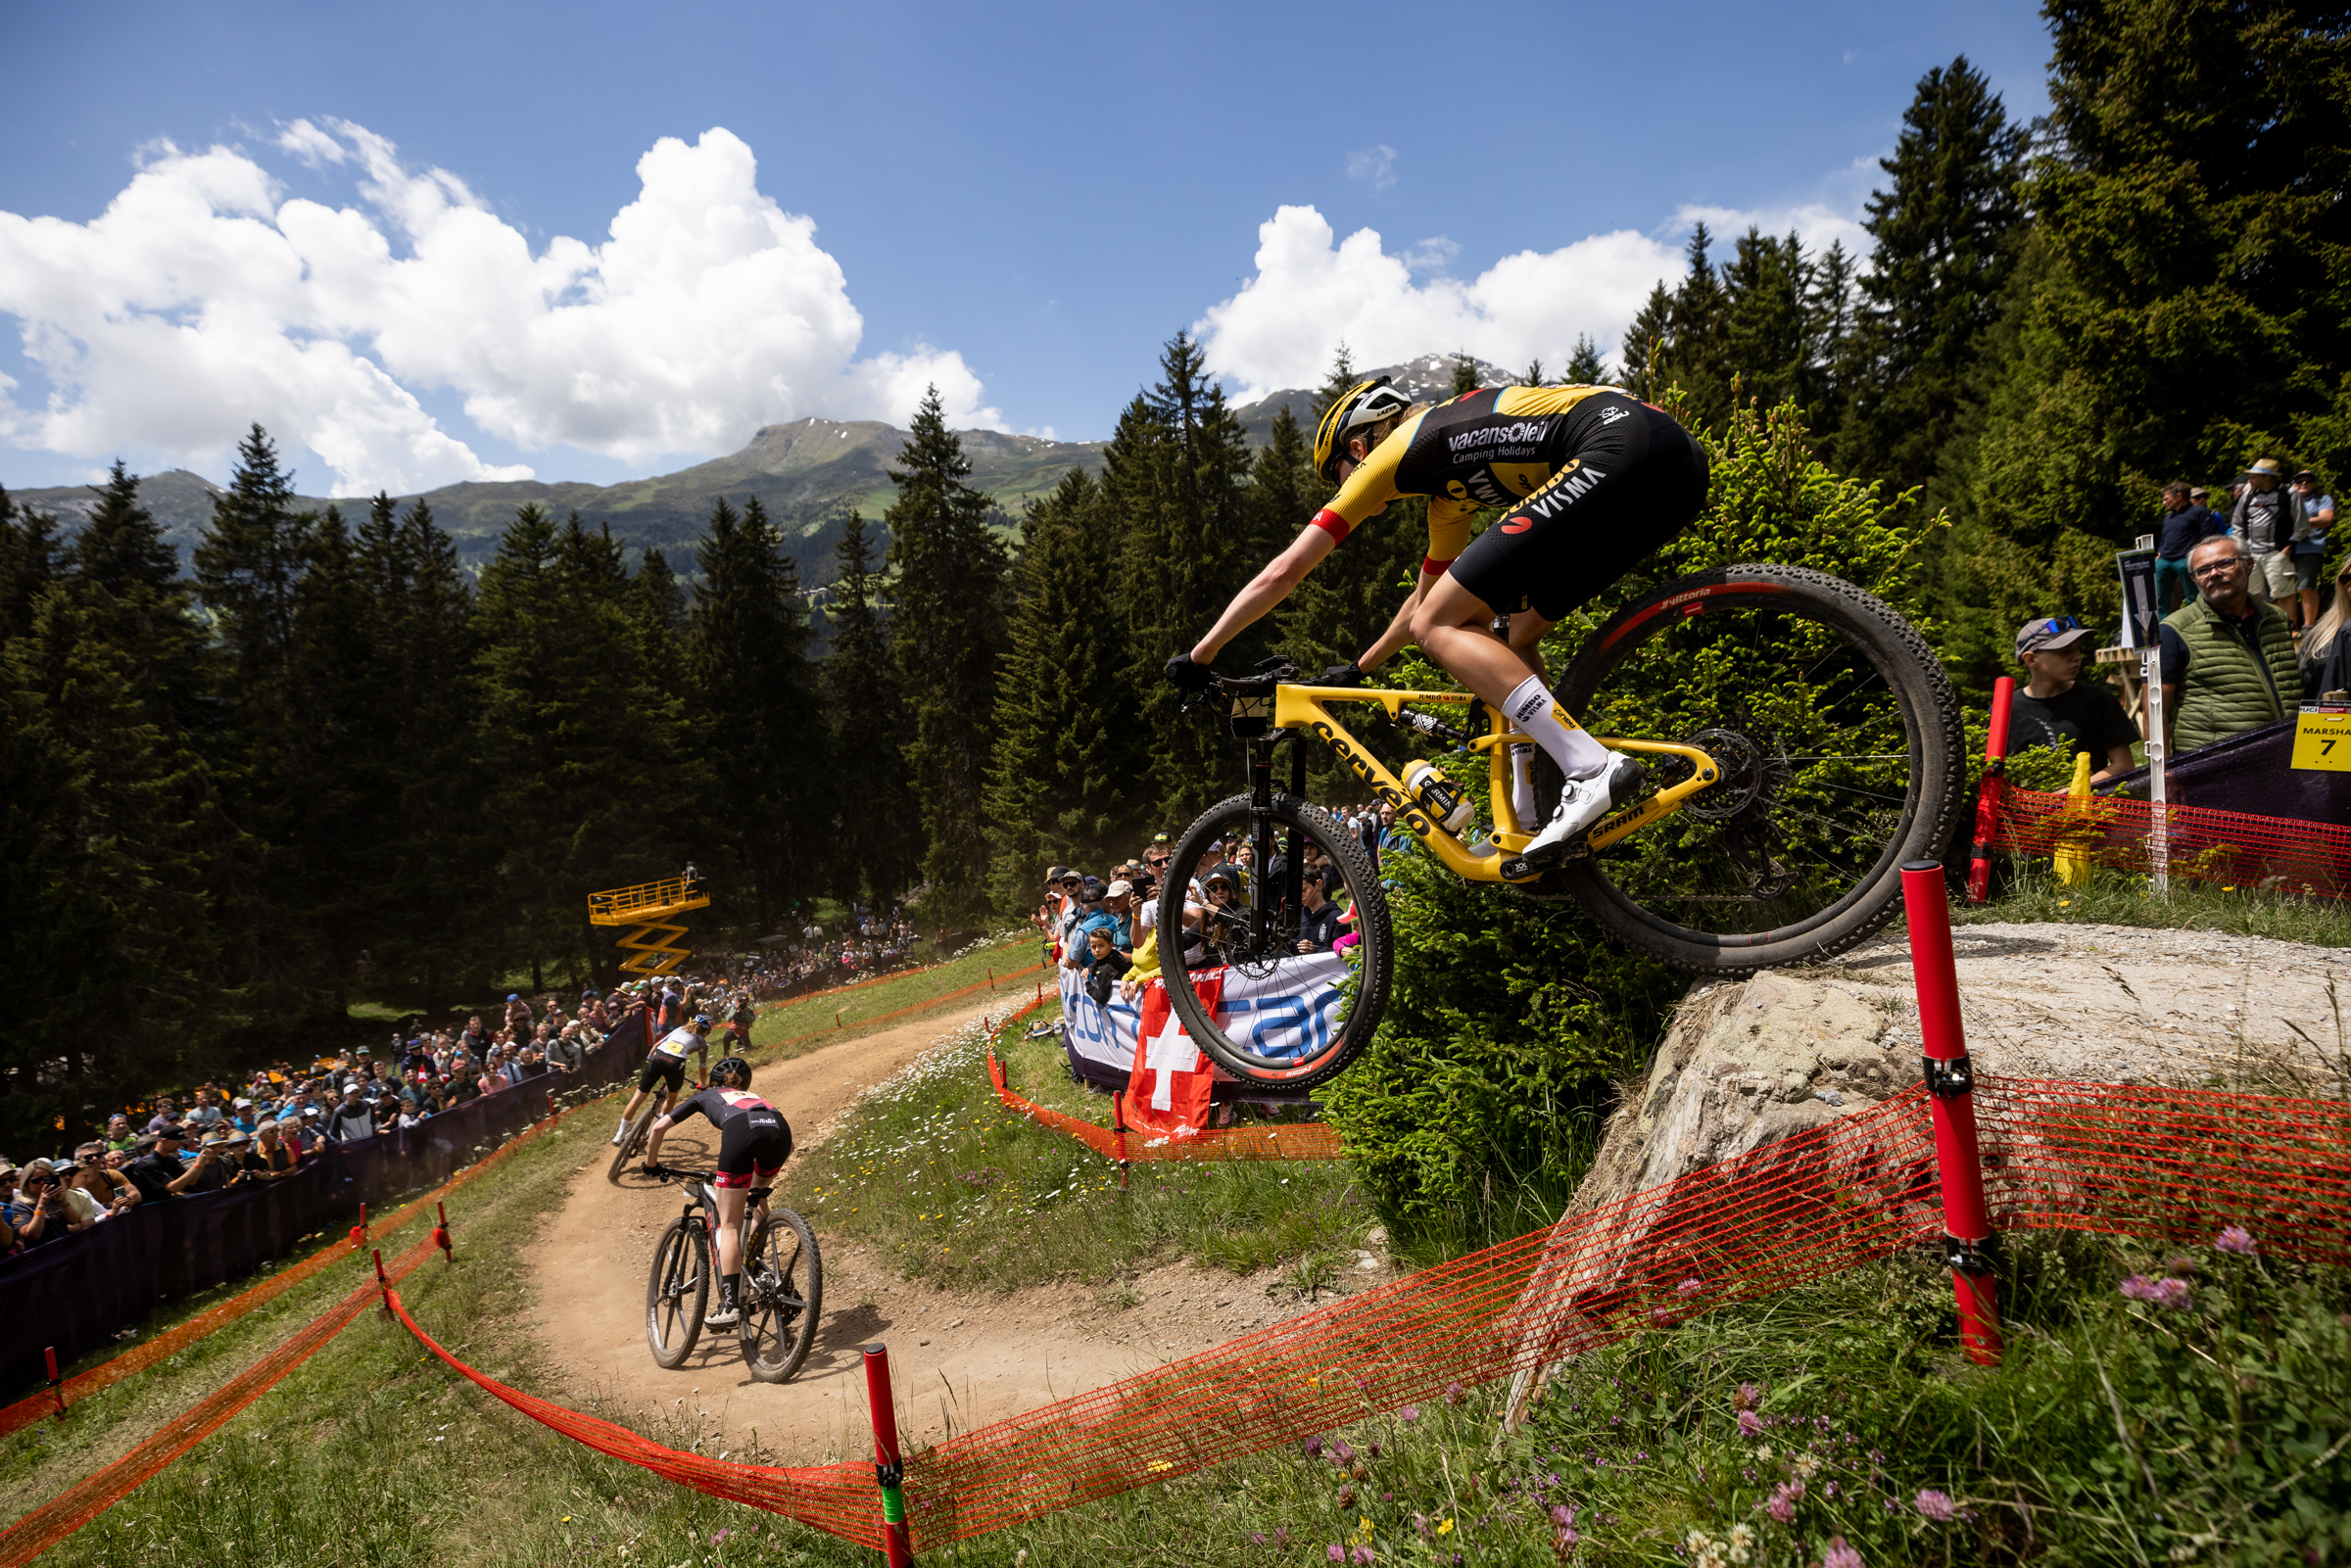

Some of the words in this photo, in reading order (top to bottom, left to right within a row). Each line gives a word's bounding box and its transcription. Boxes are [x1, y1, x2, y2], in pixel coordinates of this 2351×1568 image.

[1376, 404, 1398, 417] LAZER
[1453, 449, 1495, 464] Camping
[1498, 445, 1536, 457] Holidays
[1531, 467, 1607, 519] VISMA
[1668, 588, 1711, 605] vittoria
[1515, 693, 1541, 721] JUMBO
[1527, 698, 1548, 717] VISMA
[2321, 739, 2337, 756] 7
[1424, 780, 1452, 809] GRMIN
[1592, 806, 1645, 839] SRAM
